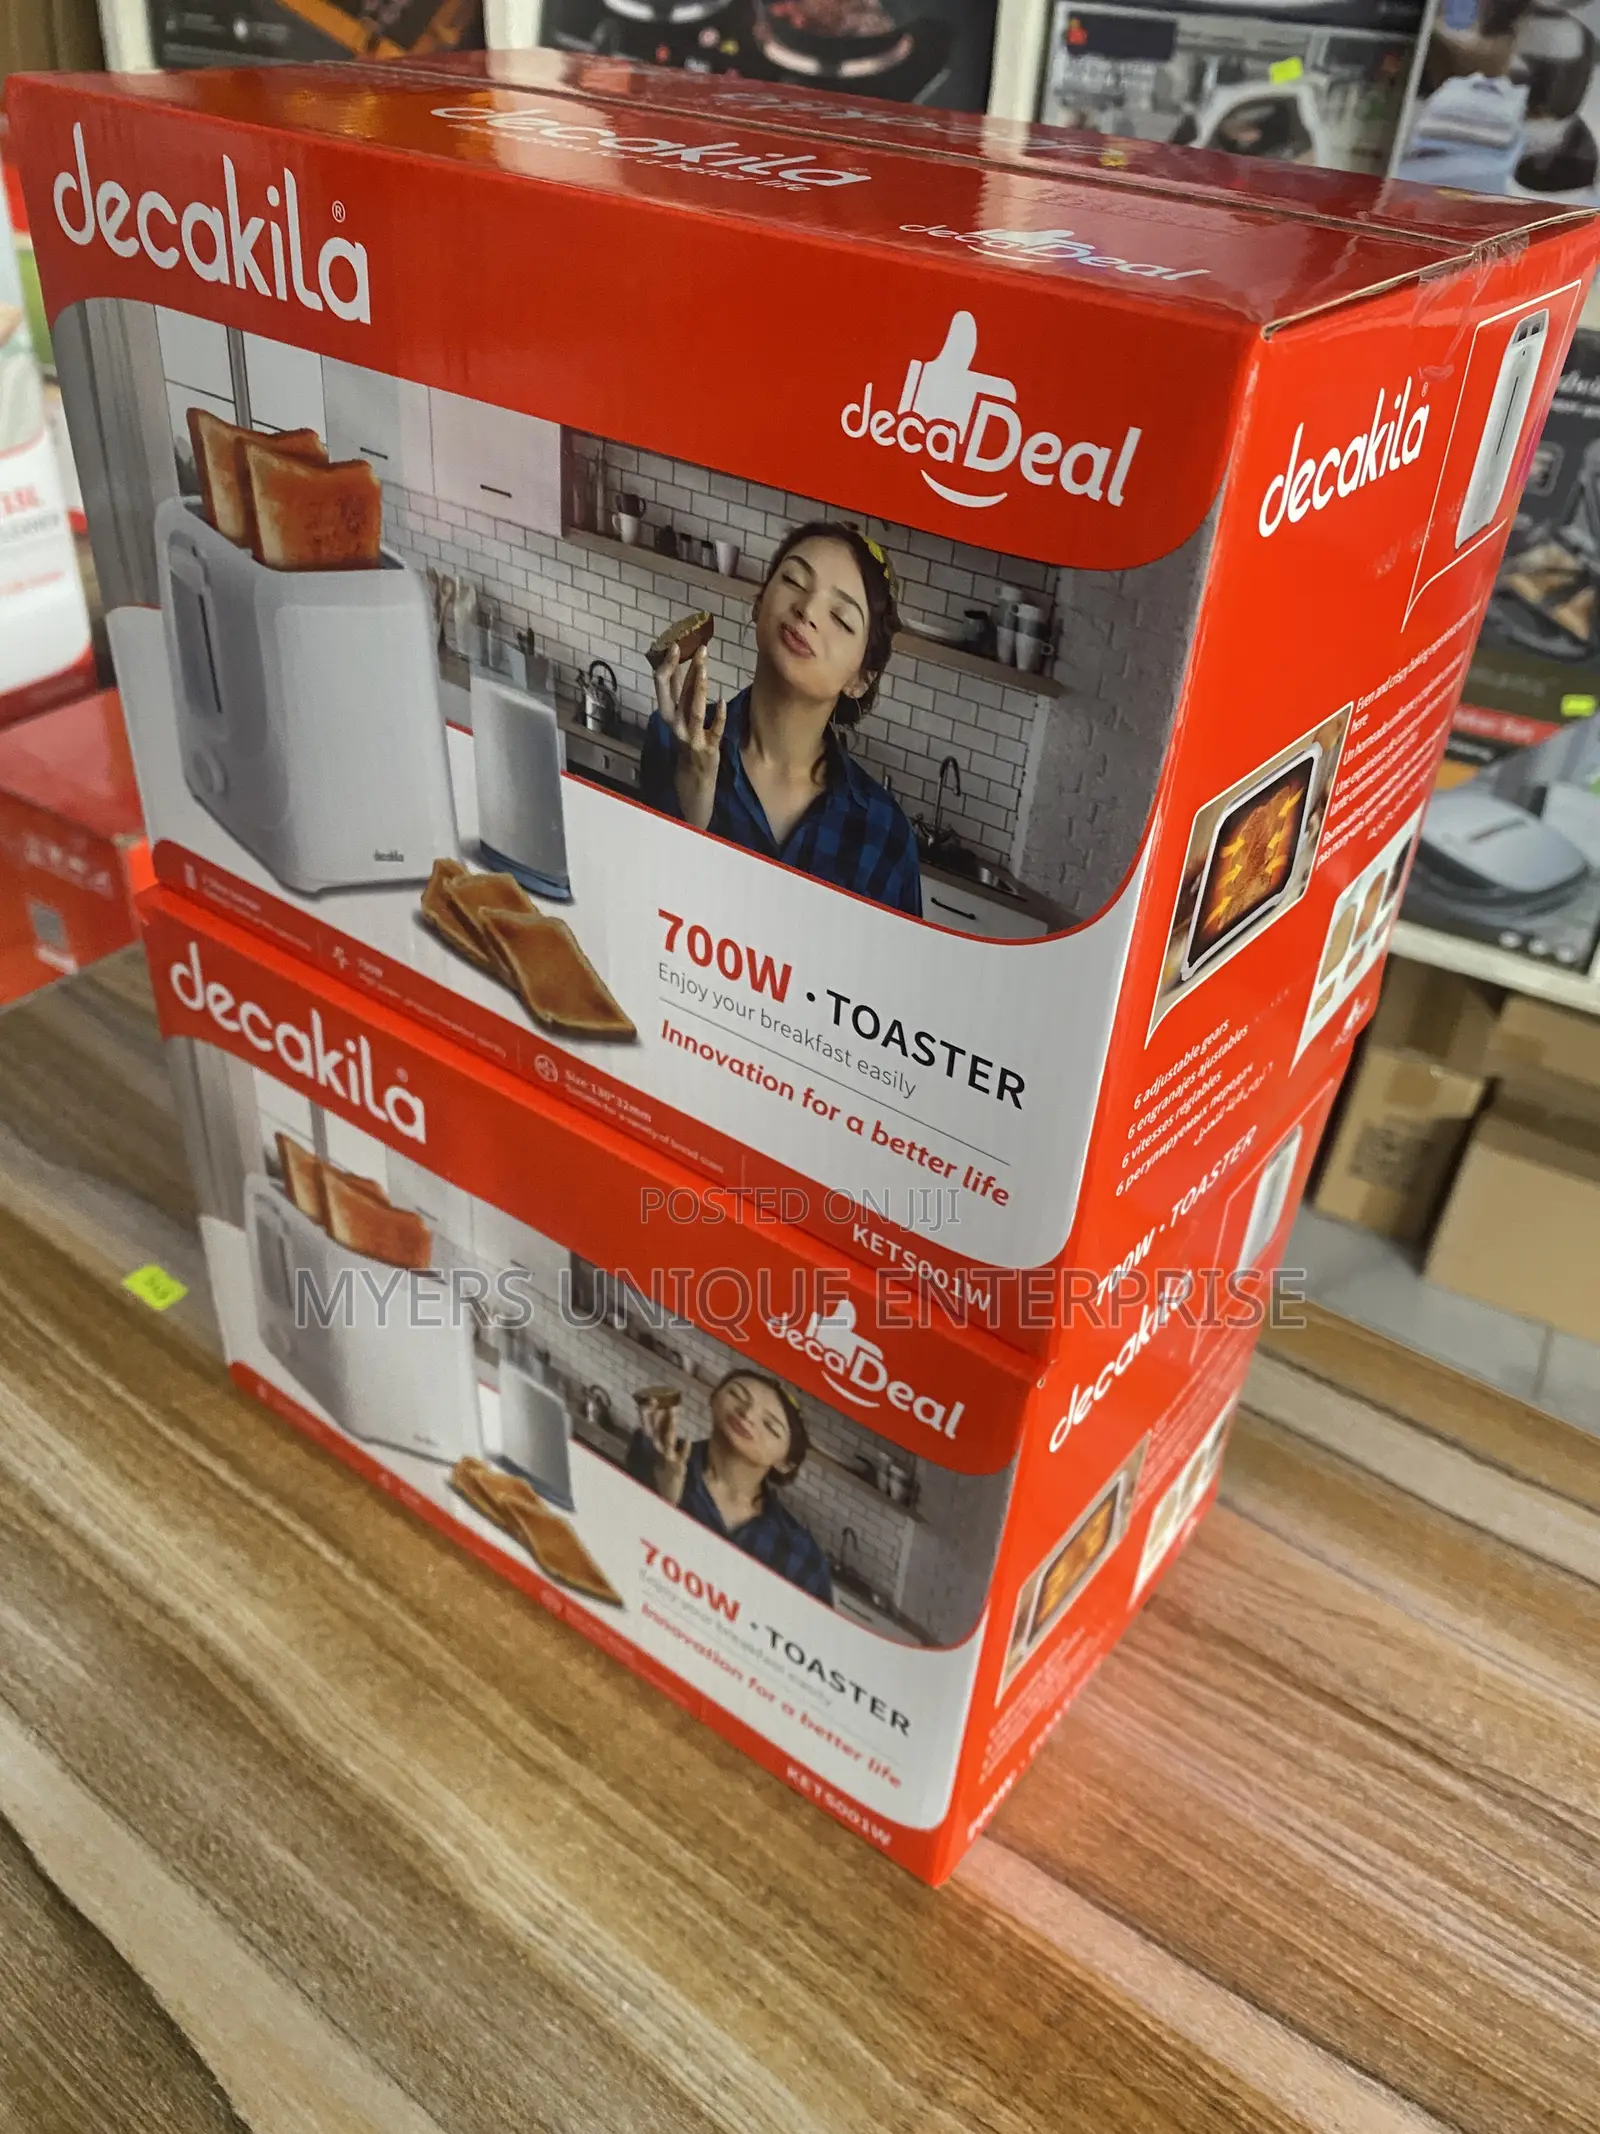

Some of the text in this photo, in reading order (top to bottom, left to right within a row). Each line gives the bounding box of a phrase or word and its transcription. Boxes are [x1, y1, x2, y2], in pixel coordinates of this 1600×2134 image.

[430, 107, 872, 187] decakila
[661, 163, 760, 181] better
[756, 180, 812, 191] life
[53, 121, 371, 325] decakila
[900, 223, 1212, 282] decaDeal
[841, 372, 1142, 507] decaDeal
[1258, 376, 1430, 538] decakila
[170, 942, 427, 1144] decakila
[658, 908, 1026, 1110] 700W TOASTER
[658, 961, 916, 1099] Enjoy your breakfast easily
[1133, 1019, 1230, 1111] 6 adjustable gears
[660, 1019, 1011, 1207] Innovation for a better life
[1121, 1152, 1130, 1169] 6
[1130, 1114, 1174, 1160] vitesses
[1127, 1123, 1136, 1140] 6
[1136, 1072, 1196, 1132] engranajes
[1096, 1227, 1156, 1306] 700W
[1169, 1125, 1257, 1229] TOASTER
[1115, 1179, 1124, 1197] 6
[851, 1223, 992, 1312] KETS001W
[767, 1304, 966, 1440] decaDeal
[1049, 1269, 1192, 1453] decakila
[640, 1537, 741, 1623] 700W
[765, 1625, 912, 1738] TOASTER
[867, 1757, 902, 1790] life
